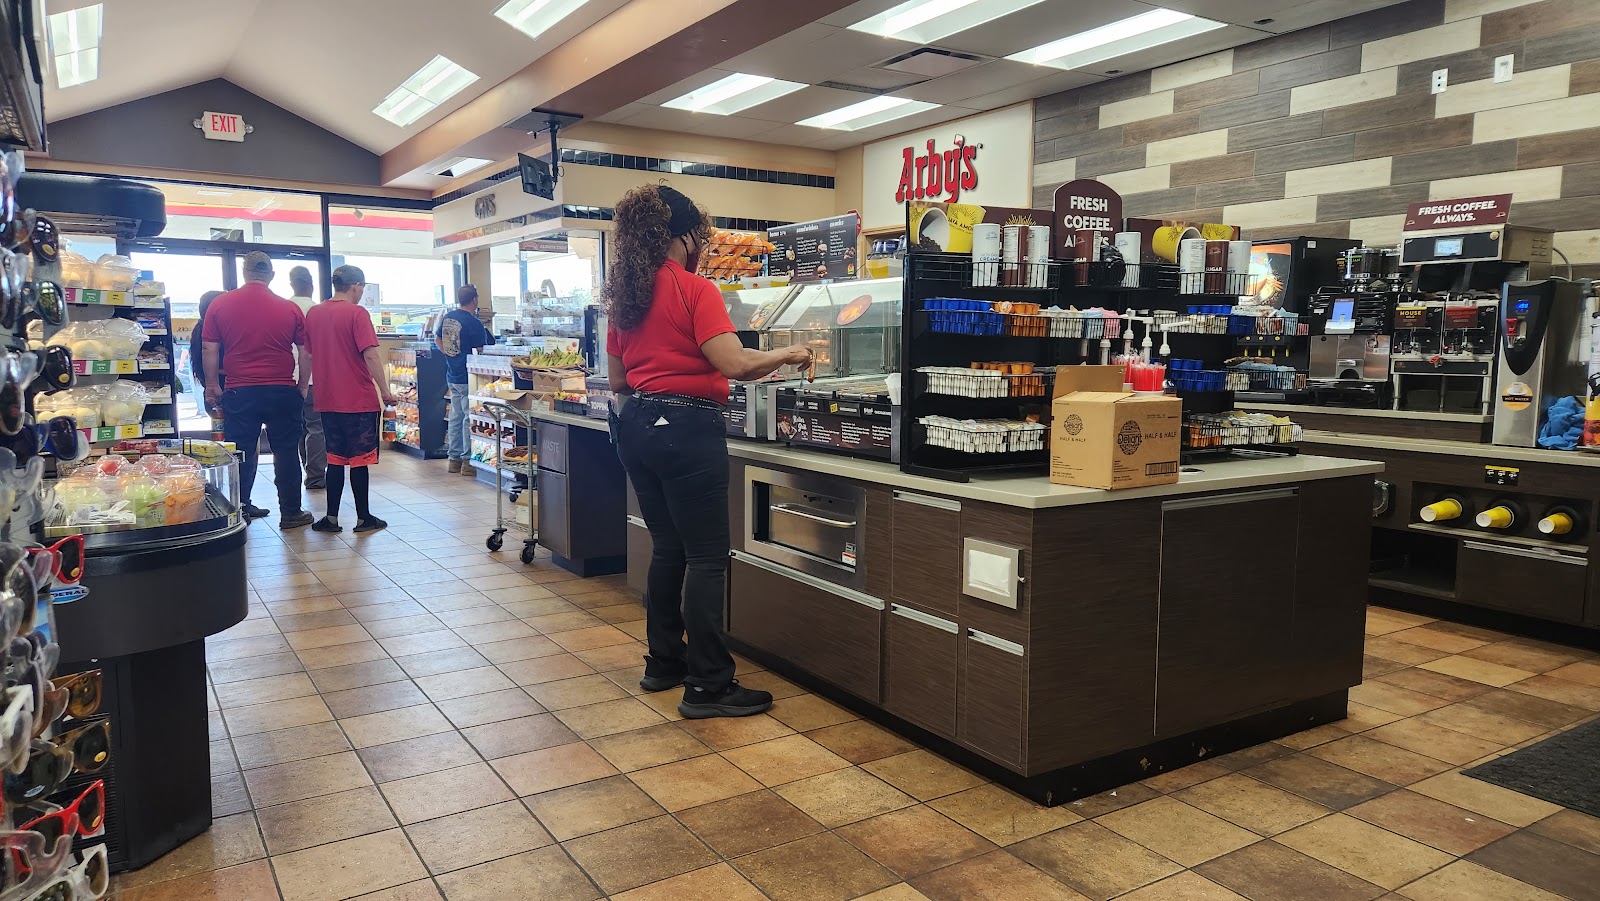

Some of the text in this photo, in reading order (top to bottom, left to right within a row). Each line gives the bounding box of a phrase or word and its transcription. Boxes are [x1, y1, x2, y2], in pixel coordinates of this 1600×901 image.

[211, 114, 237, 133] EXIT
[895, 134, 979, 203] Arby's
[1070, 195, 1108, 212] FRESH
[1418, 200, 1498, 216] FRESH COFFEE.
[1064, 214, 1114, 232] COFFEE.
[1432, 213, 1476, 225] ALWAYS.
[959, 223, 973, 232] AMO
[590, 401, 609, 411] TOPPIN
[1144, 432, 1158, 440] HALF
[1163, 431, 1177, 439] HALF
[542, 439, 560, 454] WASTE
[50, 589, 87, 598] DERAL
